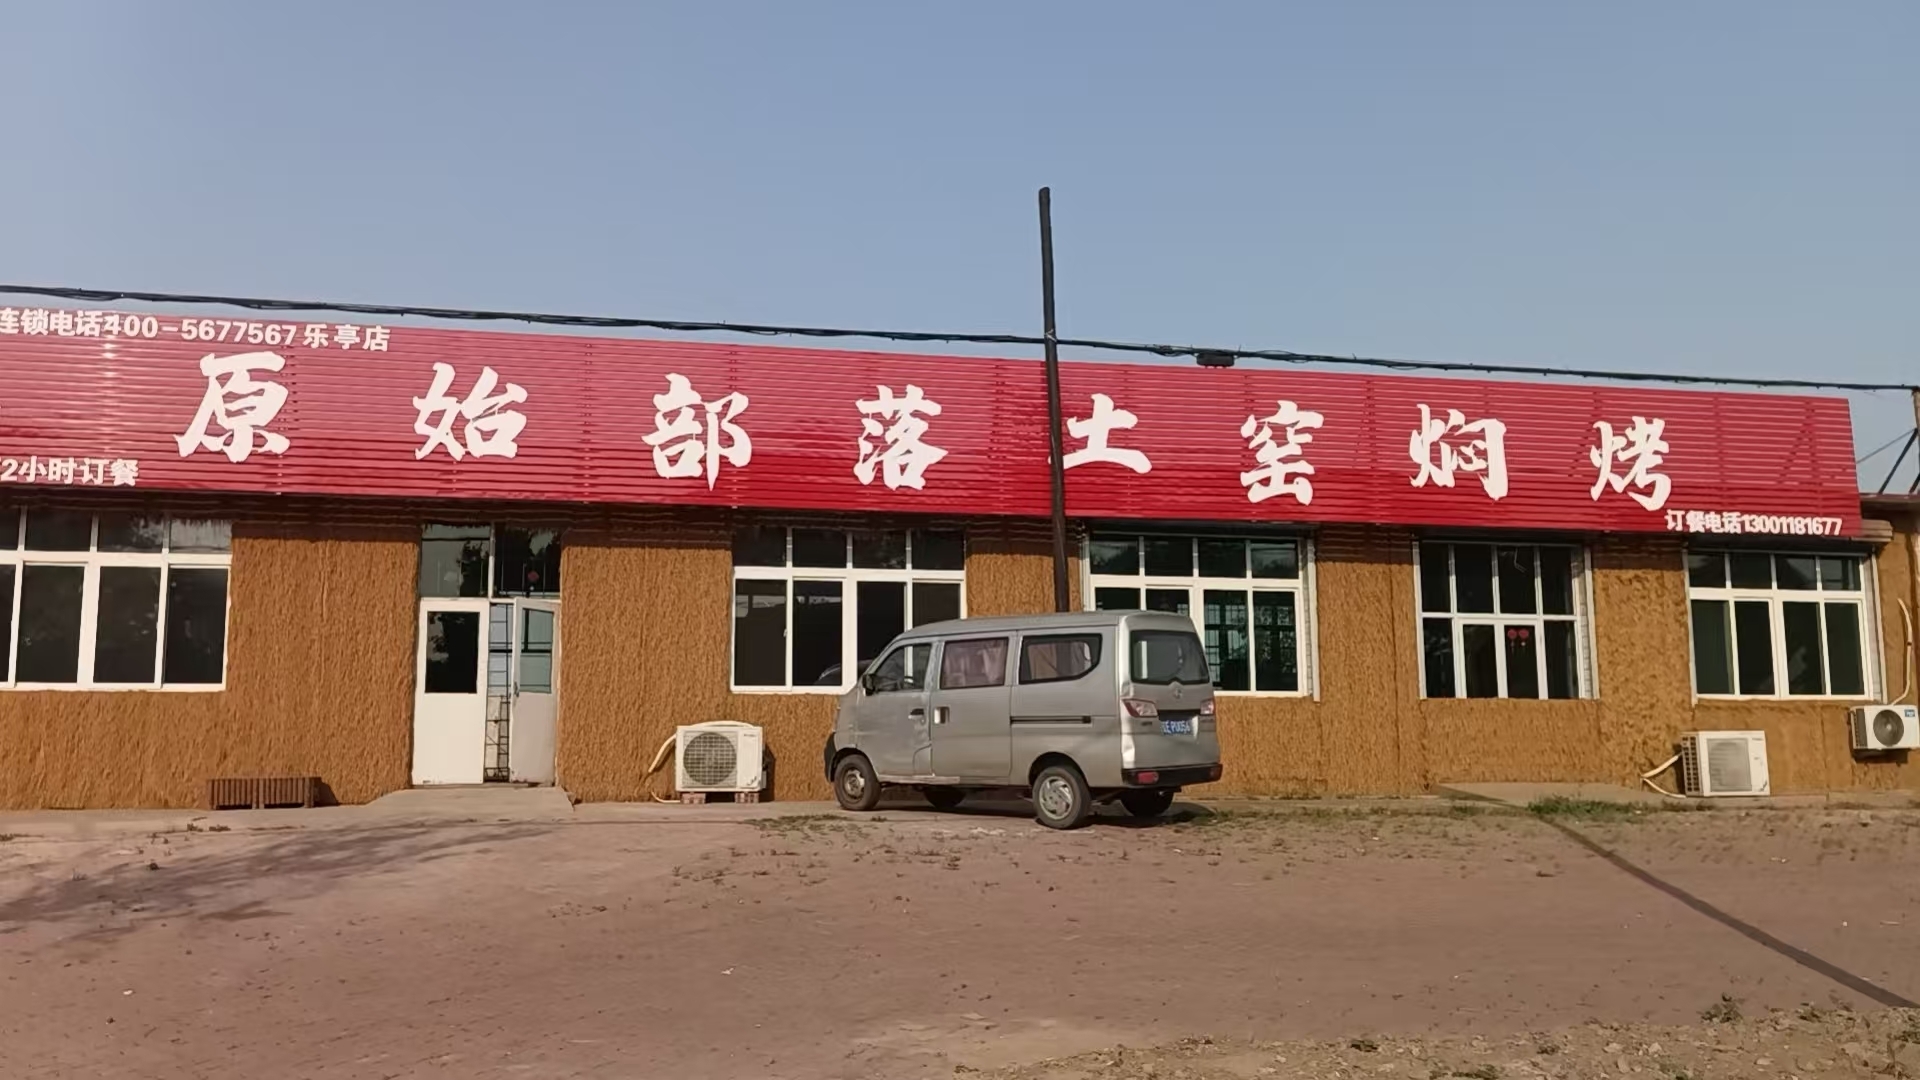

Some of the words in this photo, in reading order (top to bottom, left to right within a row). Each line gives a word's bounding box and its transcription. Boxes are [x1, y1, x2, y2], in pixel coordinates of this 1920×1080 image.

[174, 351, 1671, 511] 原始部落土窑焖烤
